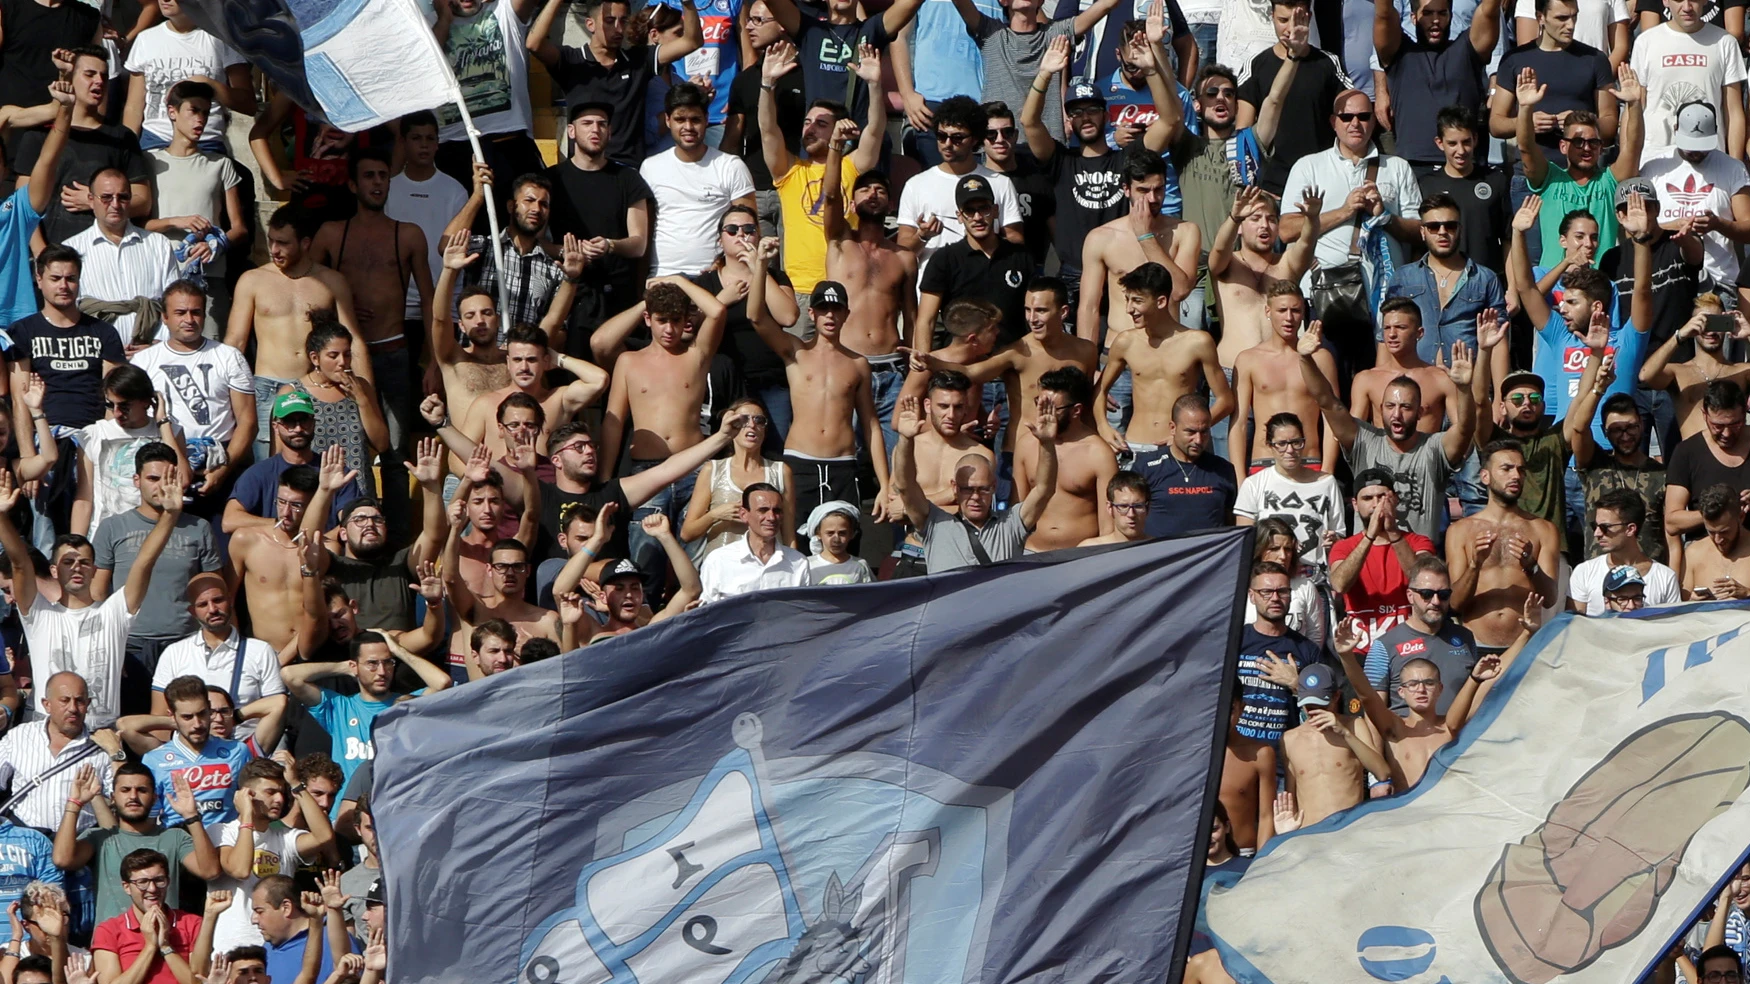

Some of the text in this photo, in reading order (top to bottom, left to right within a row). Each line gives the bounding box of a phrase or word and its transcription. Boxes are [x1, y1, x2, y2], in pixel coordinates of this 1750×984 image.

[1663, 55, 1706, 66] CASH
[820, 62, 848, 72] EMPORI
[1663, 208, 1705, 218] adida
[55, 361, 87, 369] DENIM
[1168, 486, 1186, 495] SSC
[1379, 604, 1397, 614] SIX
[1401, 638, 1424, 655] Lete
